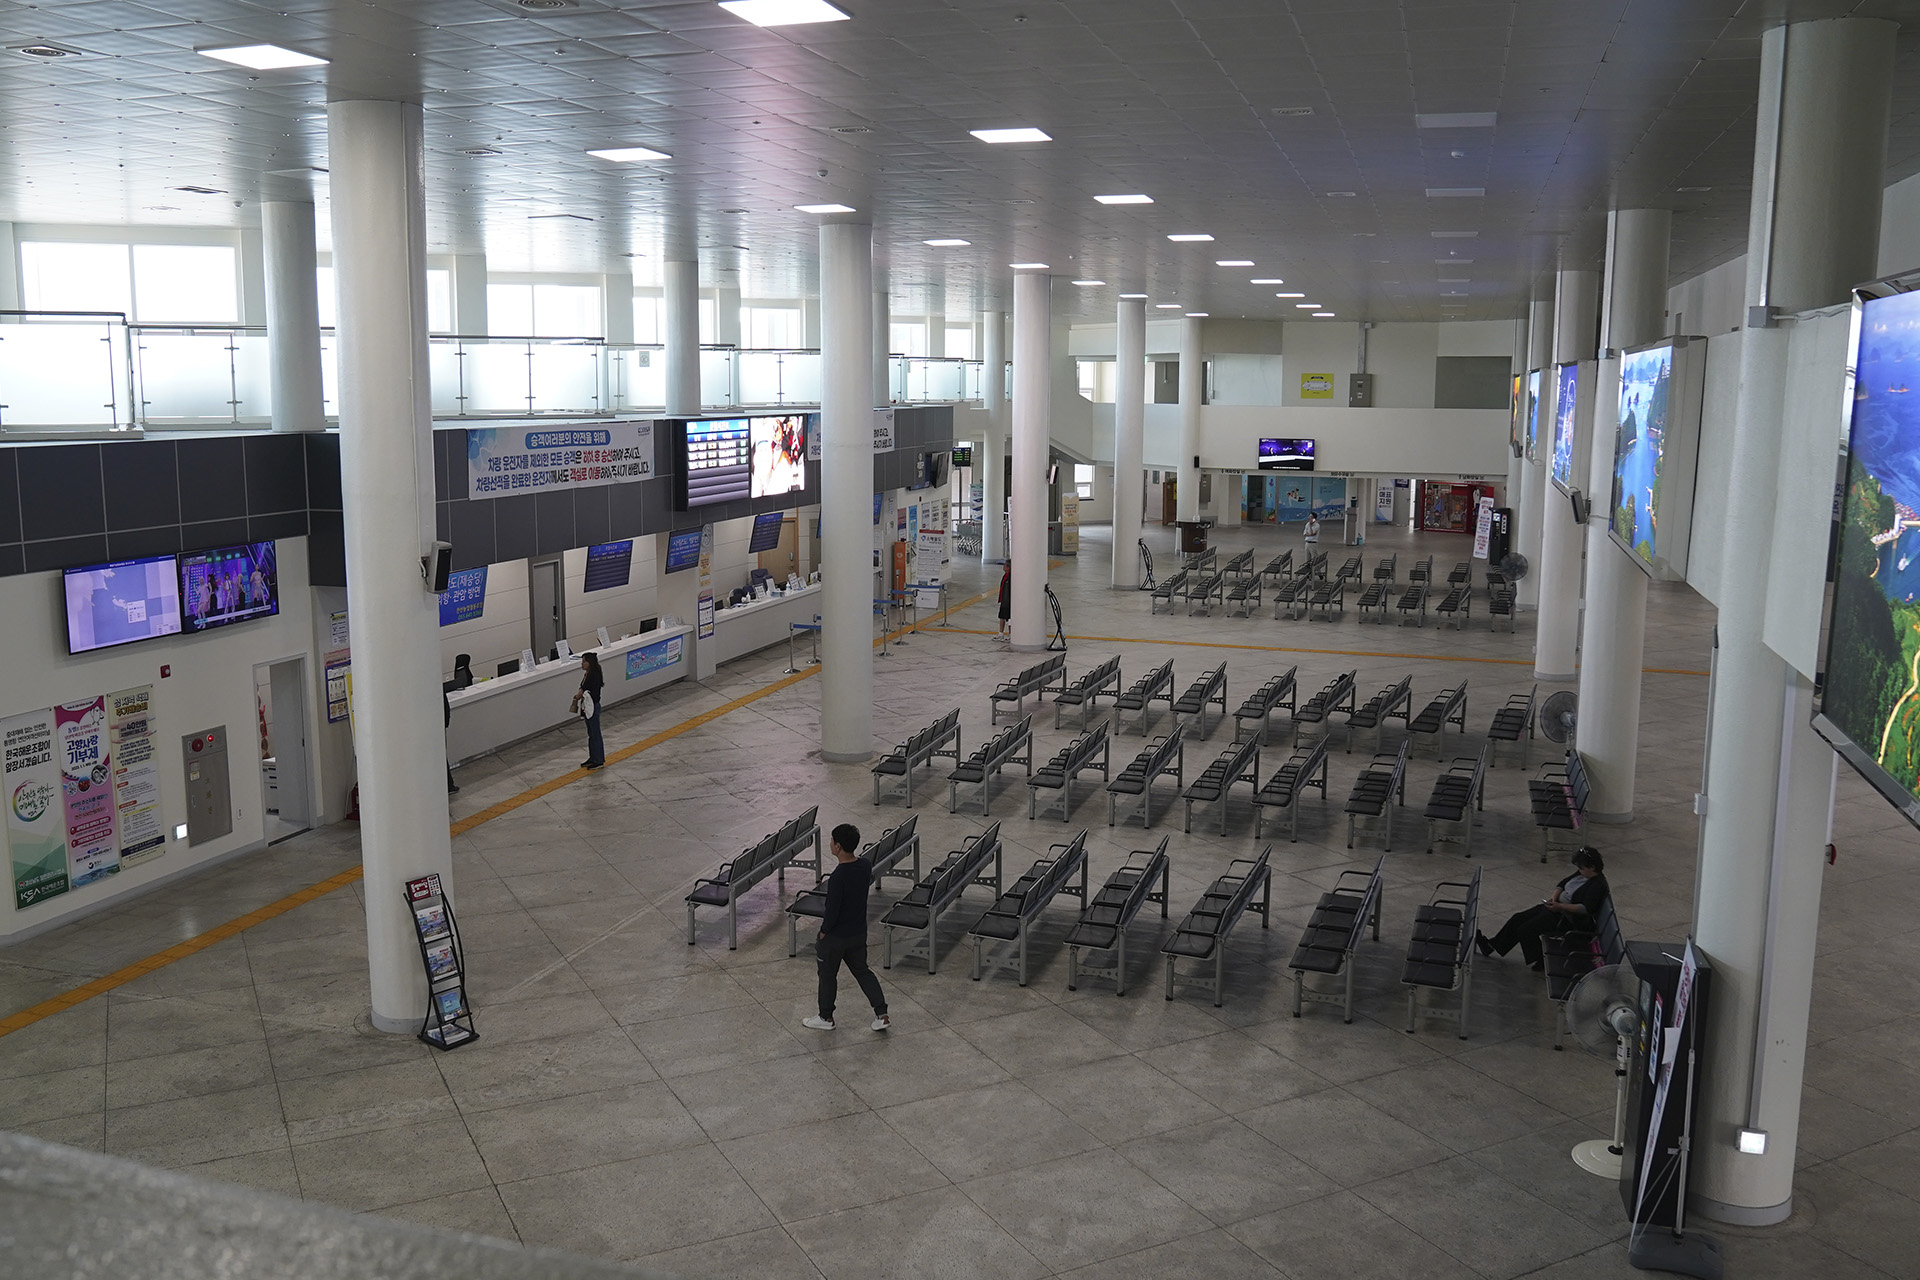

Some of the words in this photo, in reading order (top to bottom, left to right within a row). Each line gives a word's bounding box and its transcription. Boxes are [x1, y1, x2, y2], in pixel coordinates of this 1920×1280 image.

[531, 432, 572, 447] 승객여러분의
[572, 432, 592, 444] 안전을
[594, 432, 606, 444] 위해
[488, 456, 502, 472] 차량
[502, 454, 528, 471] 운전자를
[530, 452, 550, 468] 제외한
[550, 452, 562, 466] 모든
[564, 450, 582, 465] 승객은
[476, 474, 510, 492] 차량선적을
[512, 472, 532, 489] 완료한
[532, 469, 569, 487] 운전자께서도
[570, 467, 588, 482] 객실로
[612, 464, 628, 478] 주시기
[468, 586, 481, 600] 방면
[6, 740, 50, 760] 한국해운조합이
[66, 734, 99, 752] 고향사랑
[6, 752, 52, 774] 앞장서겠습니다.
[67, 746, 99, 765] 기부제
[20, 887, 41, 900] KSA
